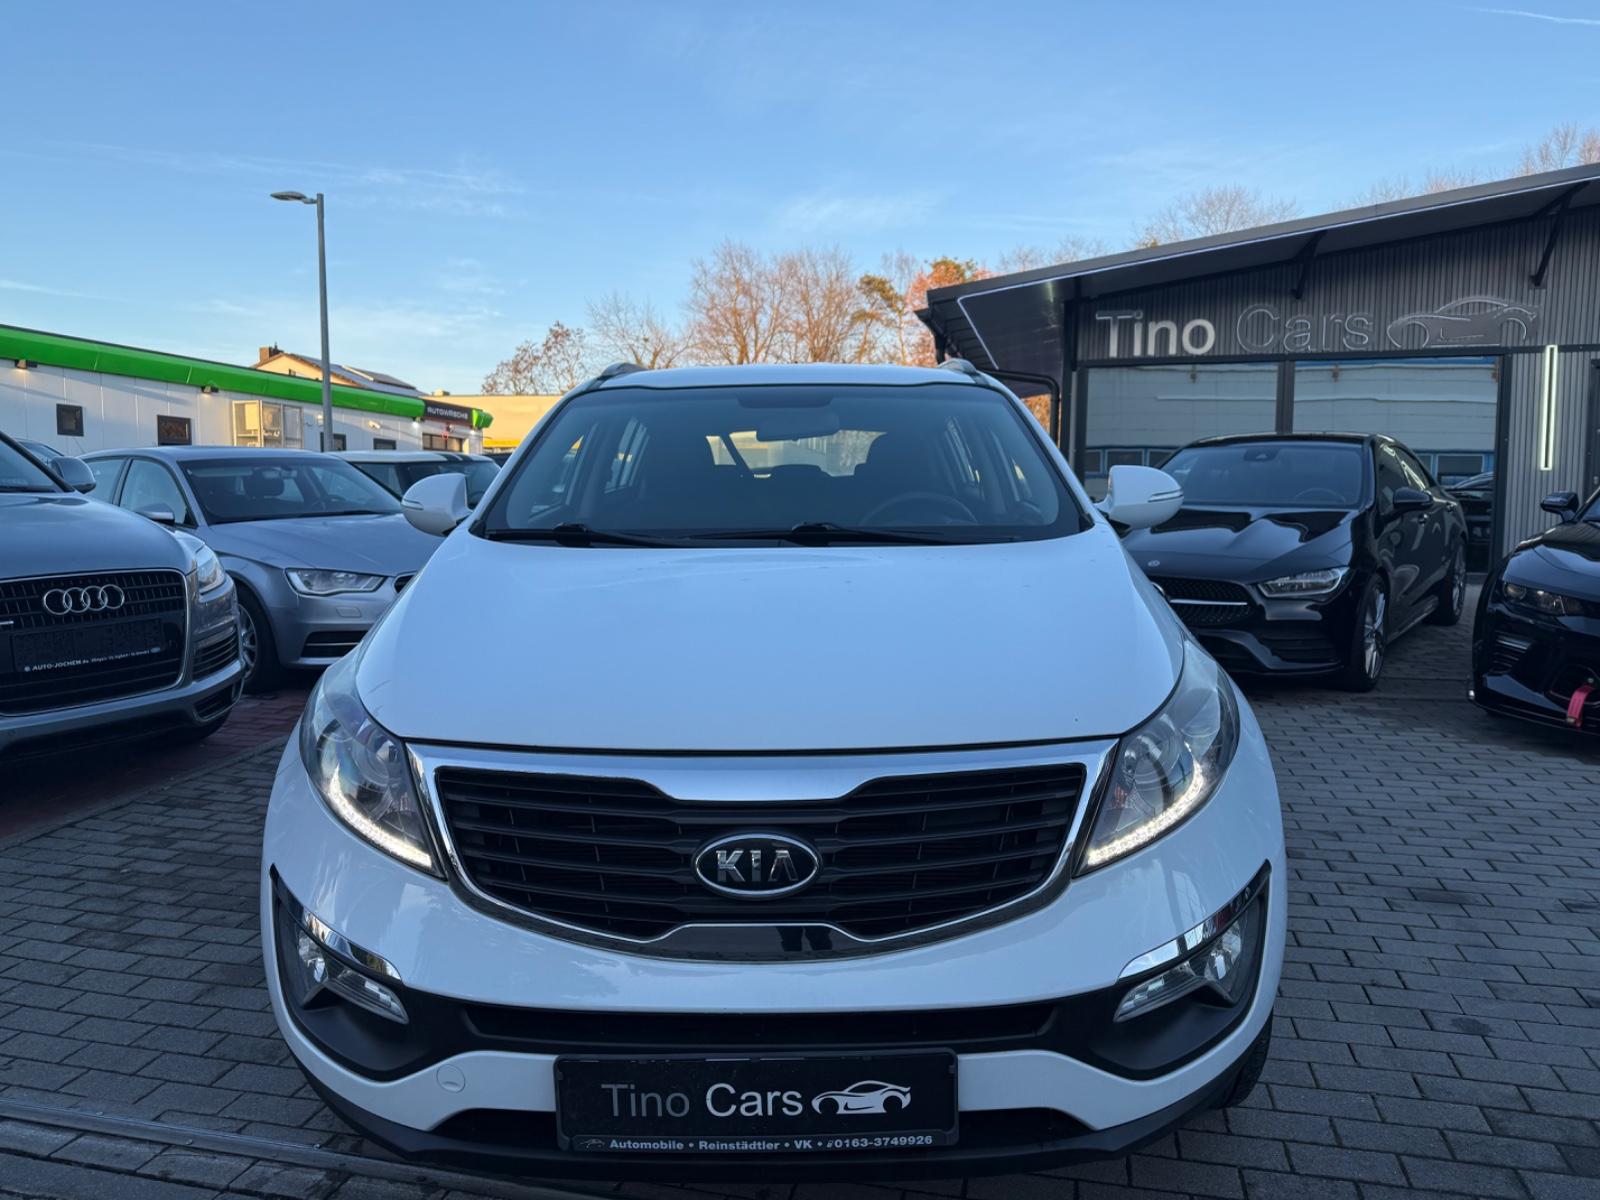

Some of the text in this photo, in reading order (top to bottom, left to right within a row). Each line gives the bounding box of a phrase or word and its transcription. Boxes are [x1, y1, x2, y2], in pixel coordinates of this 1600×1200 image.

[1095, 302, 1374, 358] Tino Cars
[715, 849, 799, 882] KIA
[601, 1082, 804, 1118] Tino Cars
[609, 1138, 685, 1150] Automobile
[698, 1138, 780, 1151] Reinstädtler
[794, 1138, 813, 1149] VK
